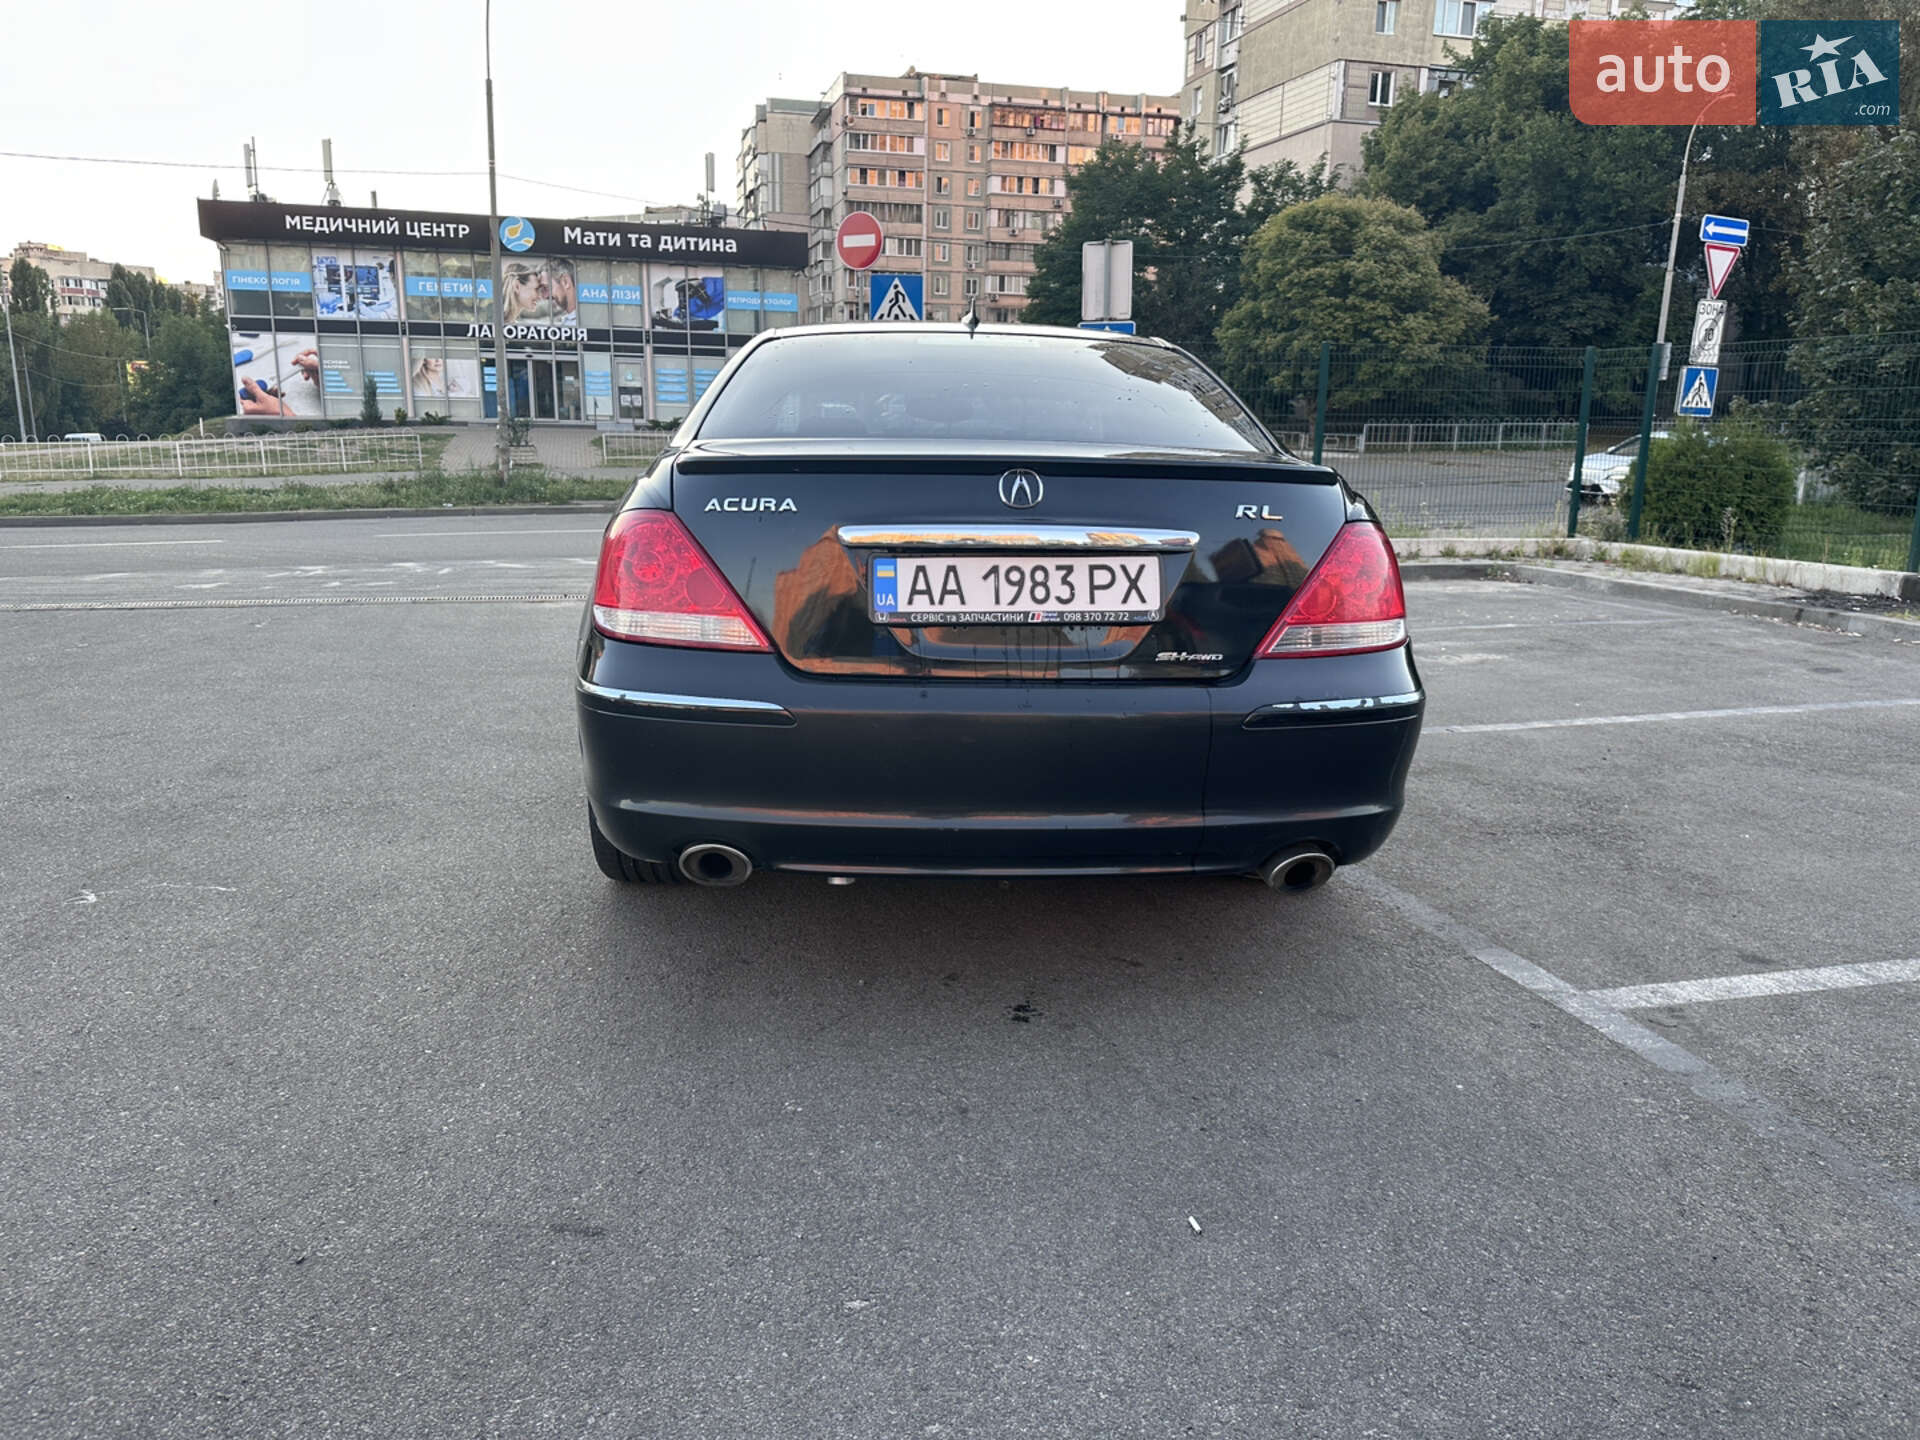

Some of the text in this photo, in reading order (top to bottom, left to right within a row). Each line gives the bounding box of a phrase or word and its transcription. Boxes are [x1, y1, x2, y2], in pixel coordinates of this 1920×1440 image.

[285, 214, 470, 239] МЕДИЧНИЙ ЦЕНТР
[563, 226, 738, 253] Мати та дитина
[581, 288, 641, 300] АНАЛІЗИ
[704, 497, 798, 512] ACURA
[1235, 504, 1283, 520] RL
[907, 564, 1148, 605] AA 1983 PX
[877, 593, 896, 605] UA
[910, 612, 944, 622] СЕРВІС
[959, 612, 1024, 622] ЗАПЧАСТИНИ
[1063, 612, 1081, 621] 098
[1084, 612, 1101, 621] 370
[1104, 612, 1115, 621] 72
[1118, 612, 1129, 621] 72
